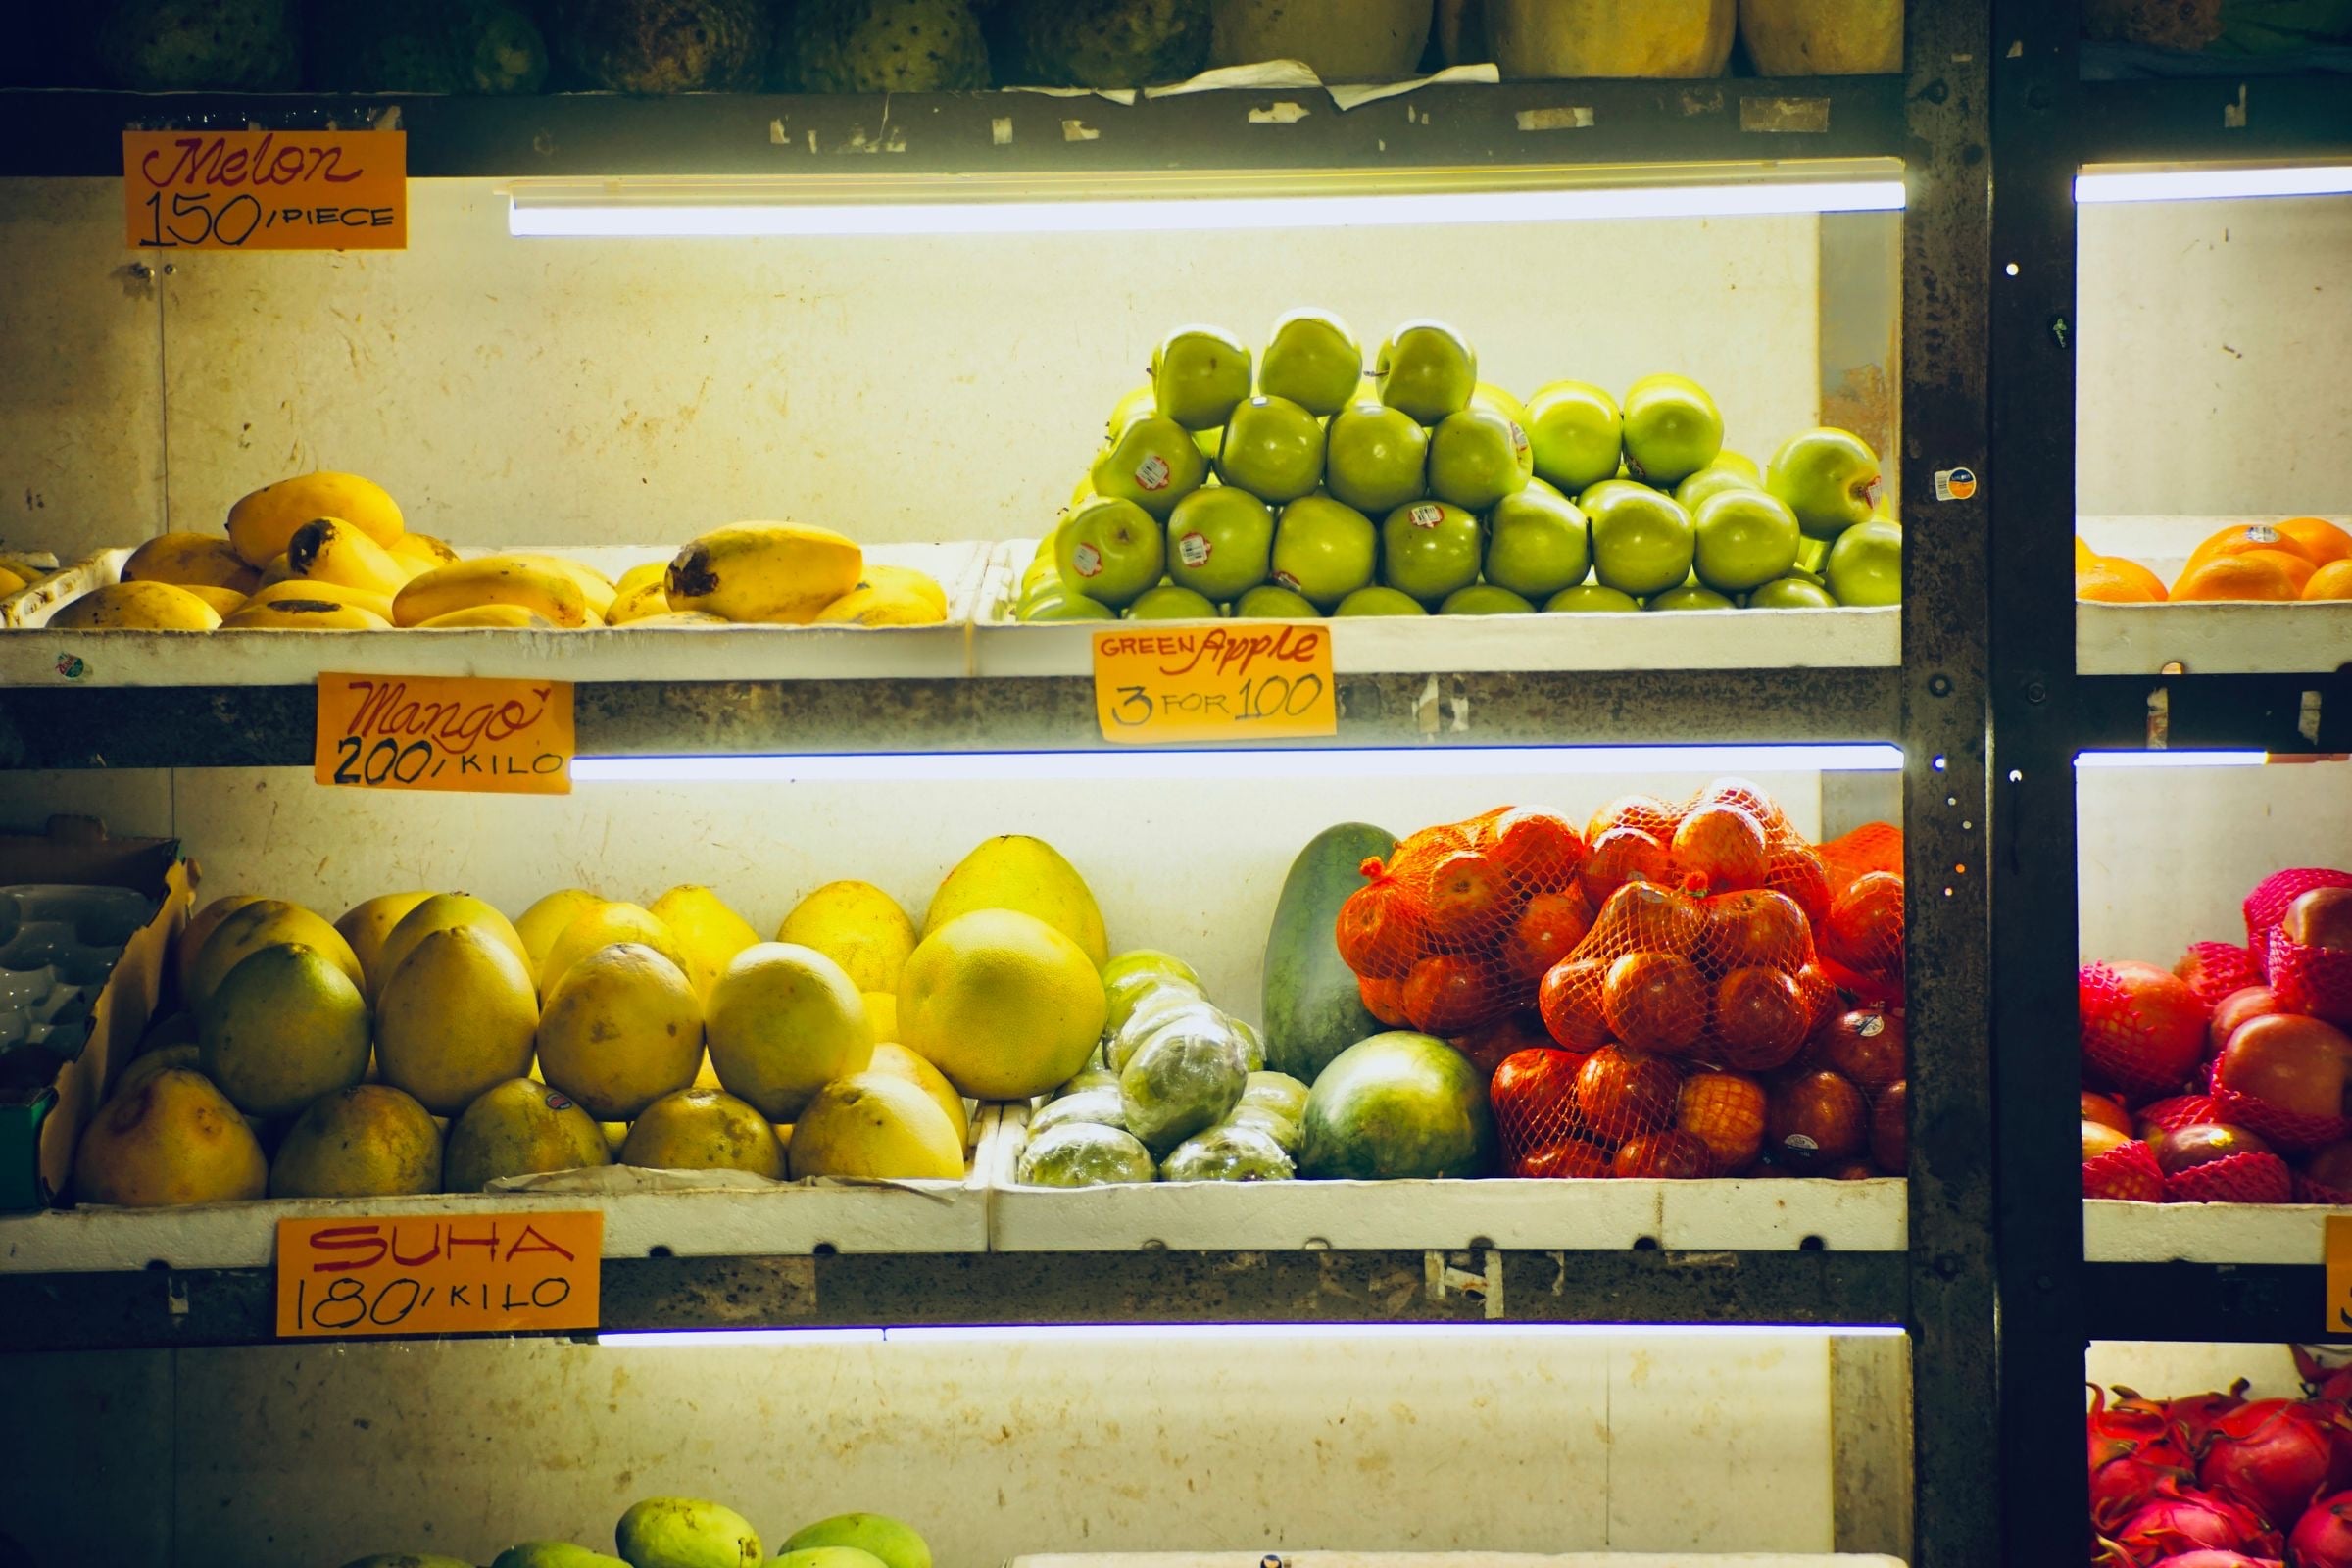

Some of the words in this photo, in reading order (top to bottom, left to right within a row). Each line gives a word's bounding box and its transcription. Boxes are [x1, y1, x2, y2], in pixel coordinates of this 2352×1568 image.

[142, 132, 364, 187] Melon
[1101, 634, 1195, 657] GREEN
[1159, 625, 1318, 676] Apple
[347, 681, 543, 754] Mango
[1111, 685, 1153, 726] 3
[1160, 693, 1230, 715] FOR
[1234, 673, 1323, 721] 100
[309, 1221, 575, 1272] SUHA
